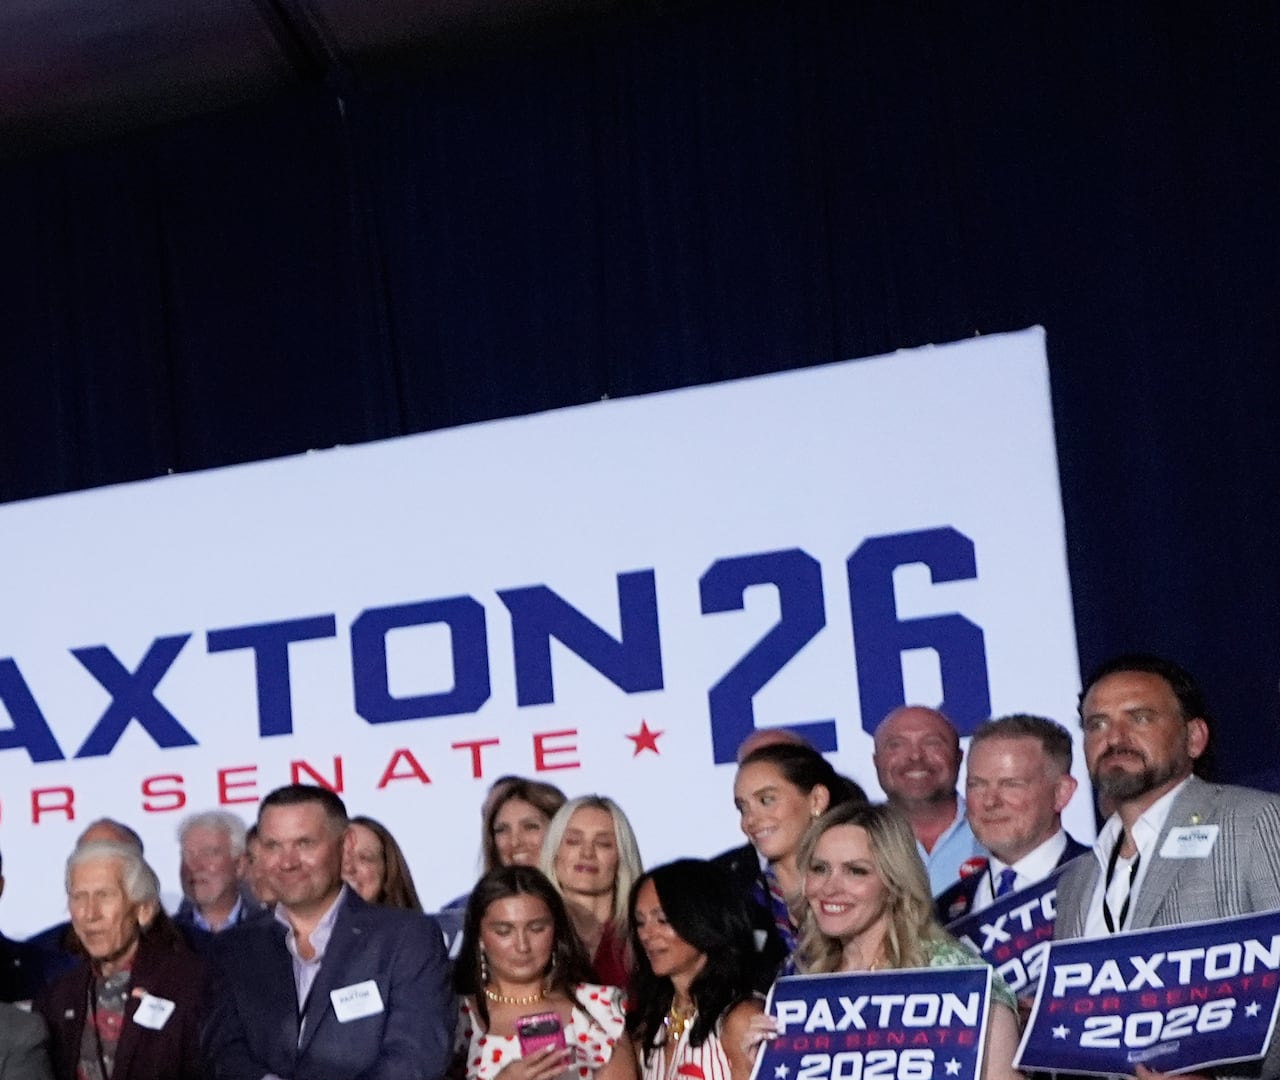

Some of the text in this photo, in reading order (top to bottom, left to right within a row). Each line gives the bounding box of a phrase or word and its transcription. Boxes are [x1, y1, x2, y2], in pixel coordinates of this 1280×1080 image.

[698, 525, 992, 765] 26
[141, 728, 582, 813] SENATE
[1052, 935, 1280, 998] PAXTON
[775, 992, 980, 1034] PAXTON
[1079, 998, 1237, 1049] 2026
